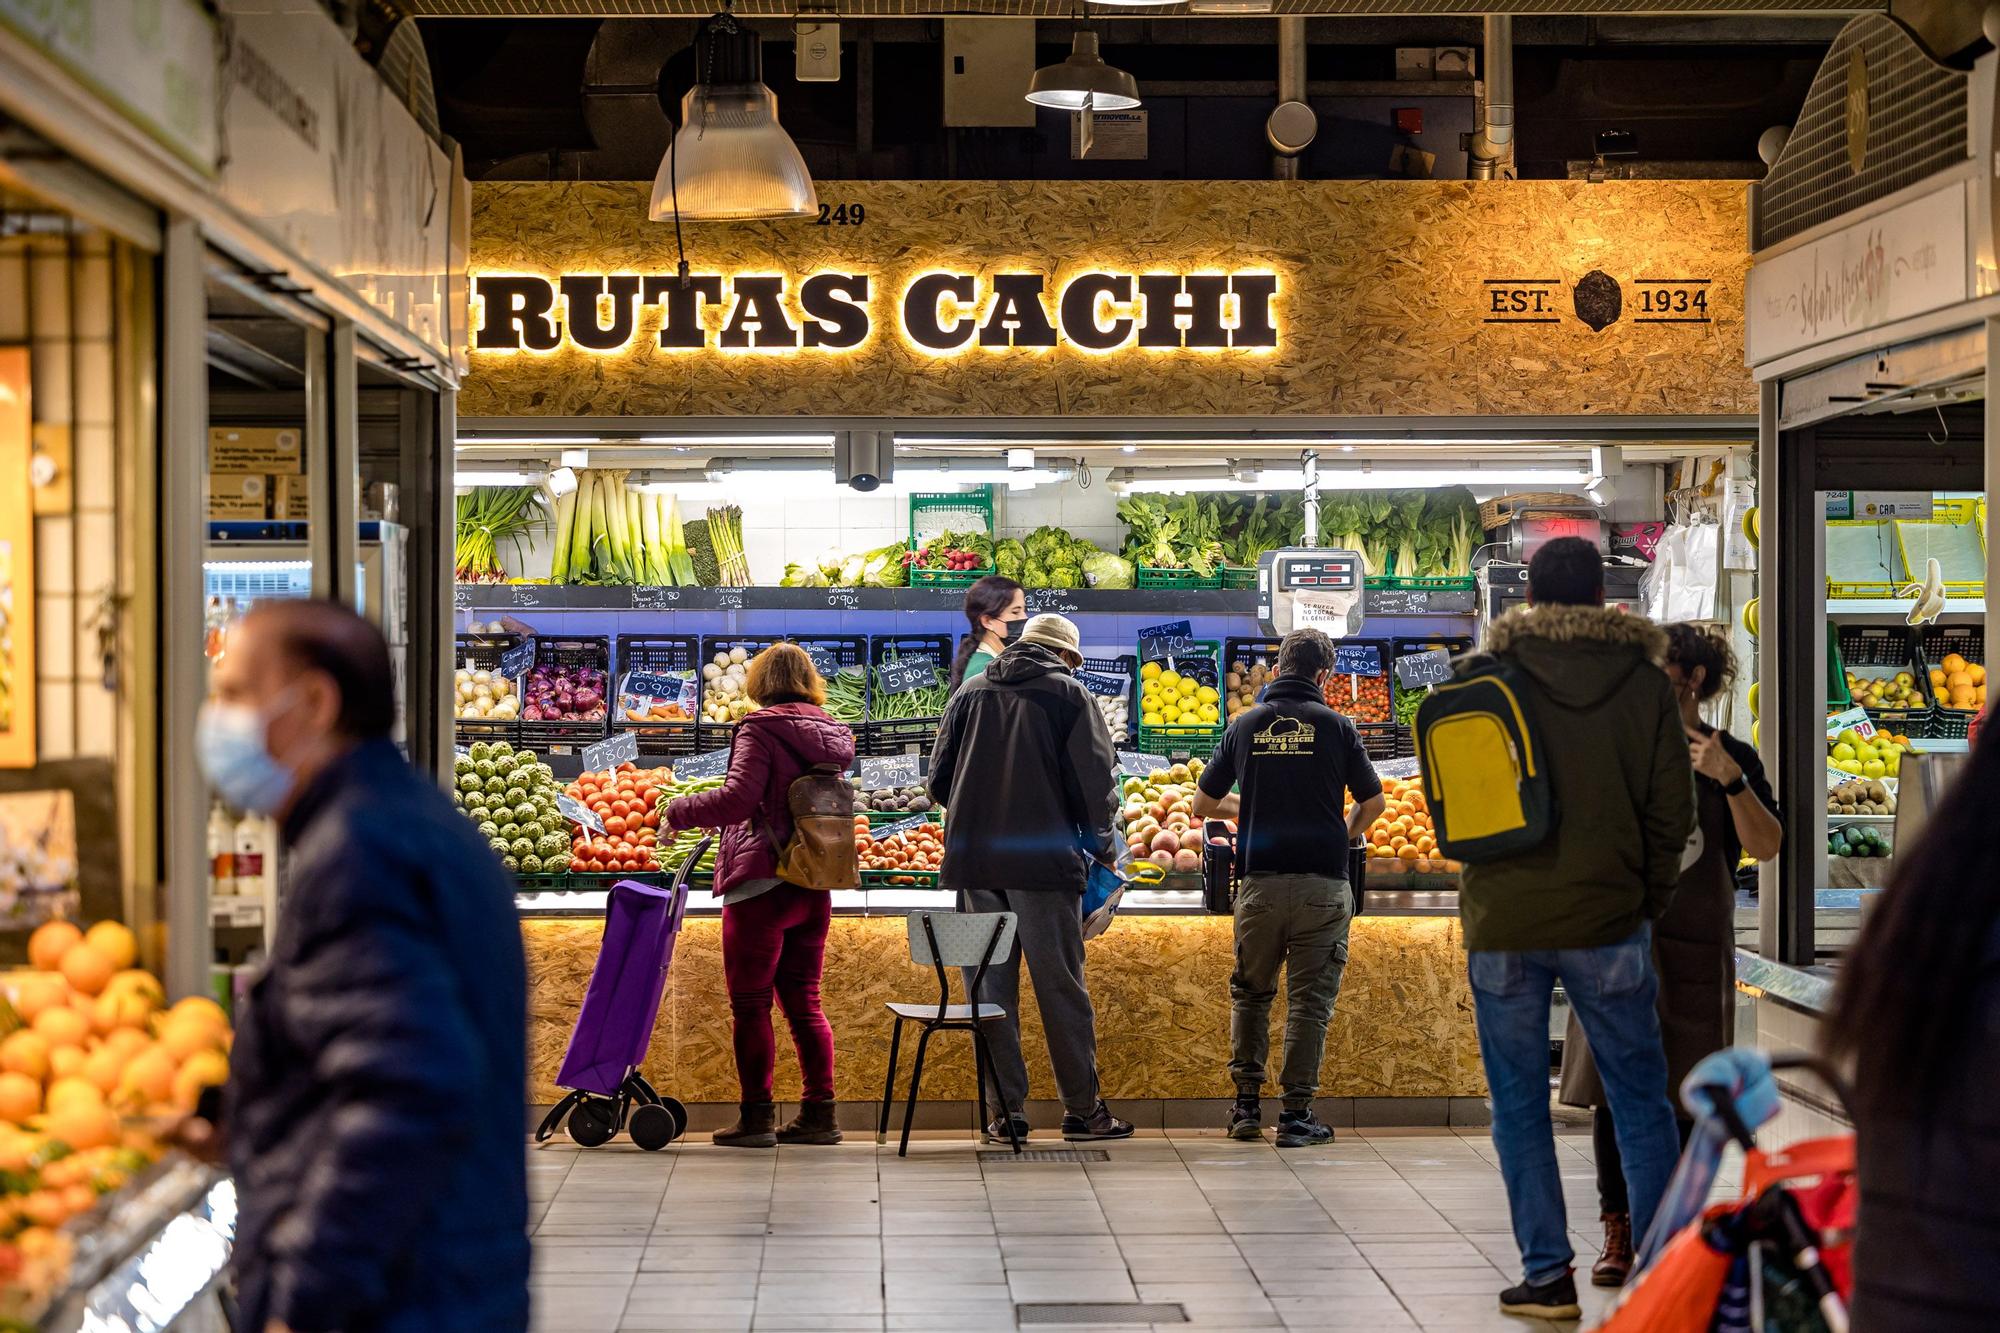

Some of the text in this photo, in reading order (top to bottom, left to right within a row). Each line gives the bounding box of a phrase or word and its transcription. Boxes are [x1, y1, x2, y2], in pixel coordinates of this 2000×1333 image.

[816, 204, 865, 226] 249
[1490, 289, 1708, 313] EST. 1934
[468, 273, 1277, 349] RUTAS CACHI
[1879, 504, 1896, 515] CAM
[1140, 623, 1179, 640] GOLDEN
[631, 671, 680, 685] ZANAHORIA
